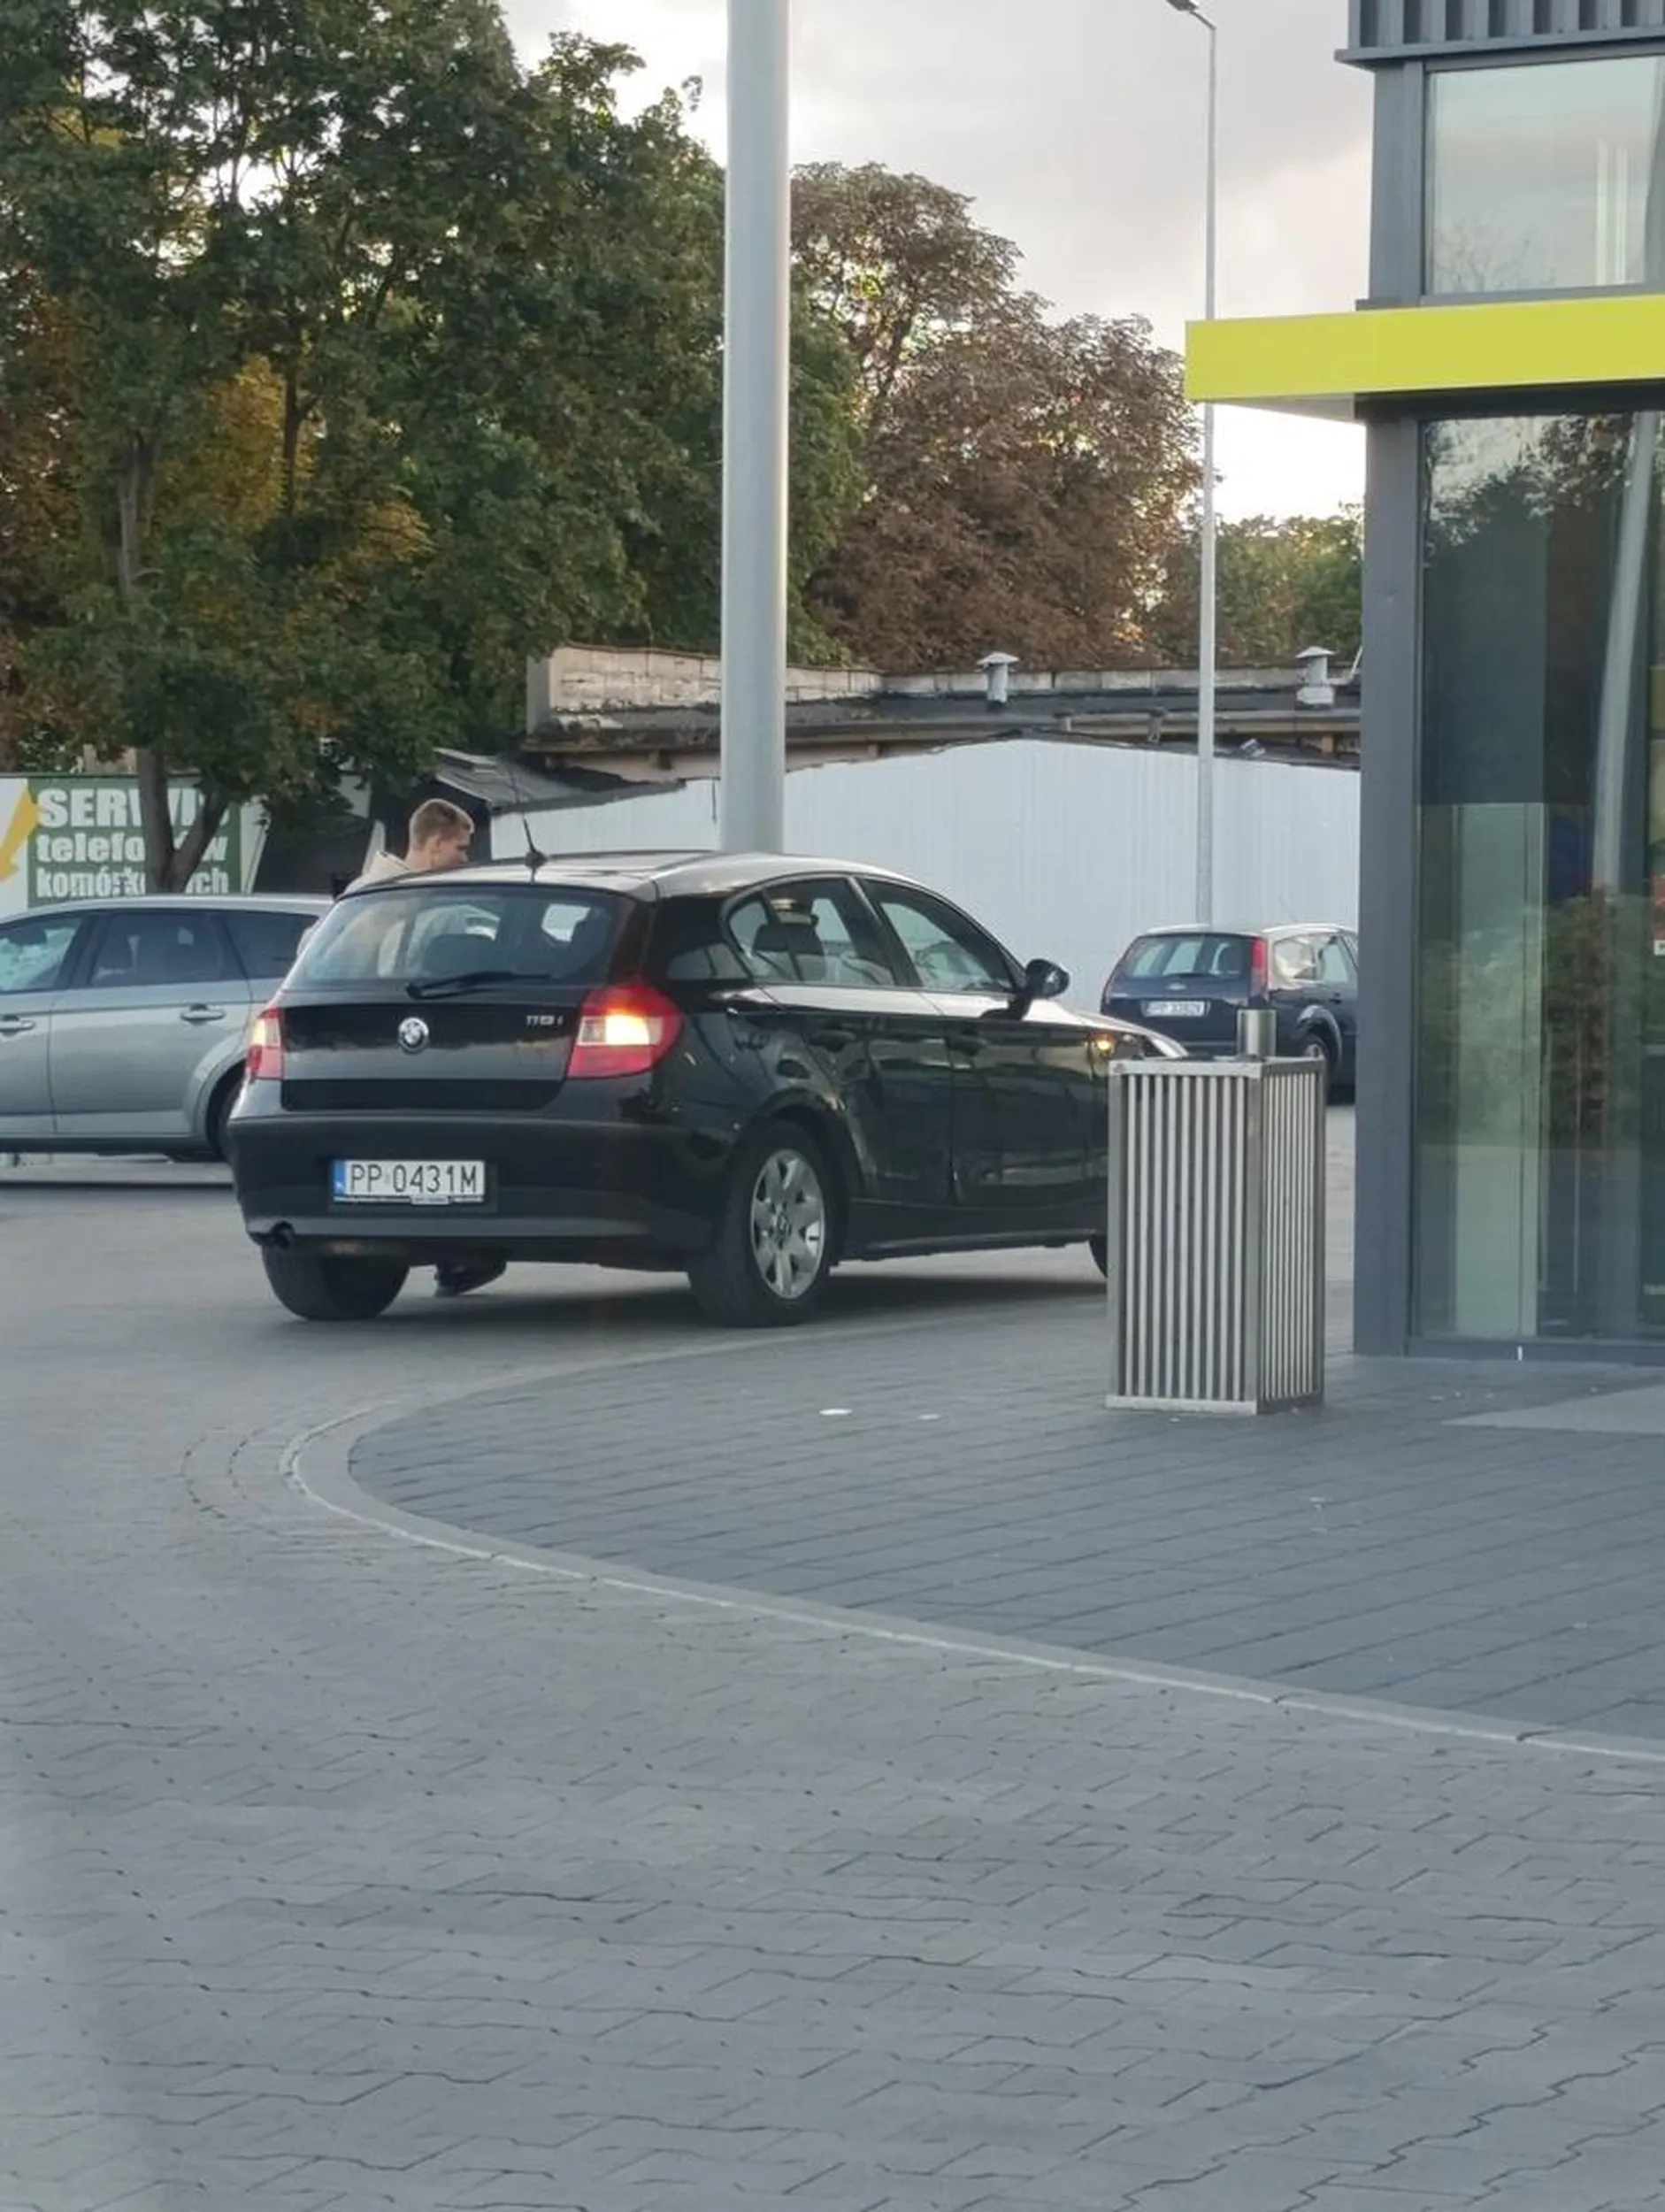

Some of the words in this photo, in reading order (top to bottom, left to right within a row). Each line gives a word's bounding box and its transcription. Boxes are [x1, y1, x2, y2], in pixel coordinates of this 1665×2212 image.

[36, 787, 229, 827] SERWI
[350, 1164, 382, 1193] PP
[393, 1164, 477, 1193] 0431M
